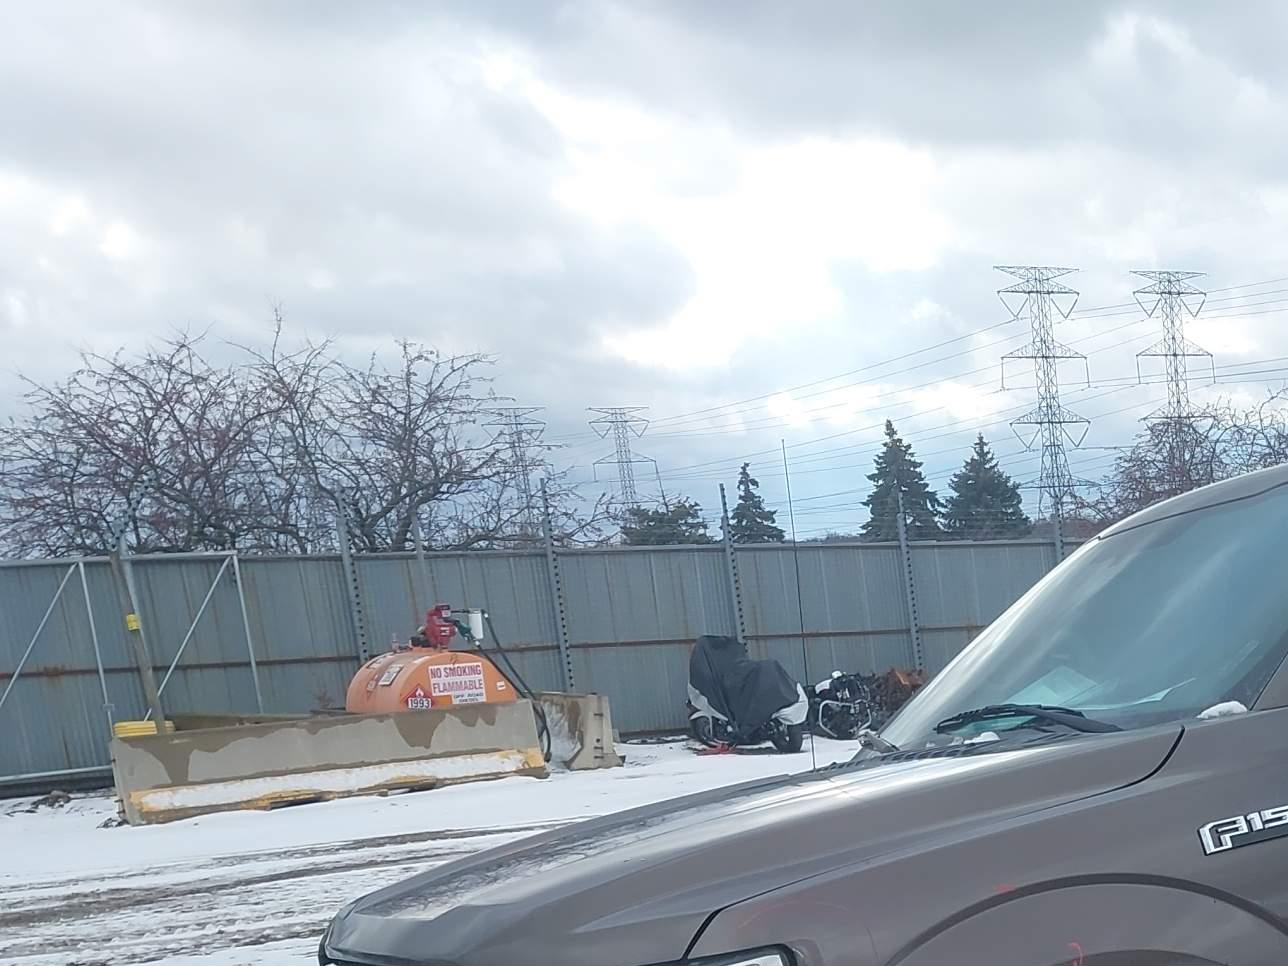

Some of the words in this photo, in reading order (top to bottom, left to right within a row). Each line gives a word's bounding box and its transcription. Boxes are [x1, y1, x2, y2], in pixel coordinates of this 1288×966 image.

[430, 668, 442, 679] NO
[444, 664, 482, 678] SMOKING
[432, 678, 483, 694] FLAMMABLE
[410, 698, 430, 709] 1993
